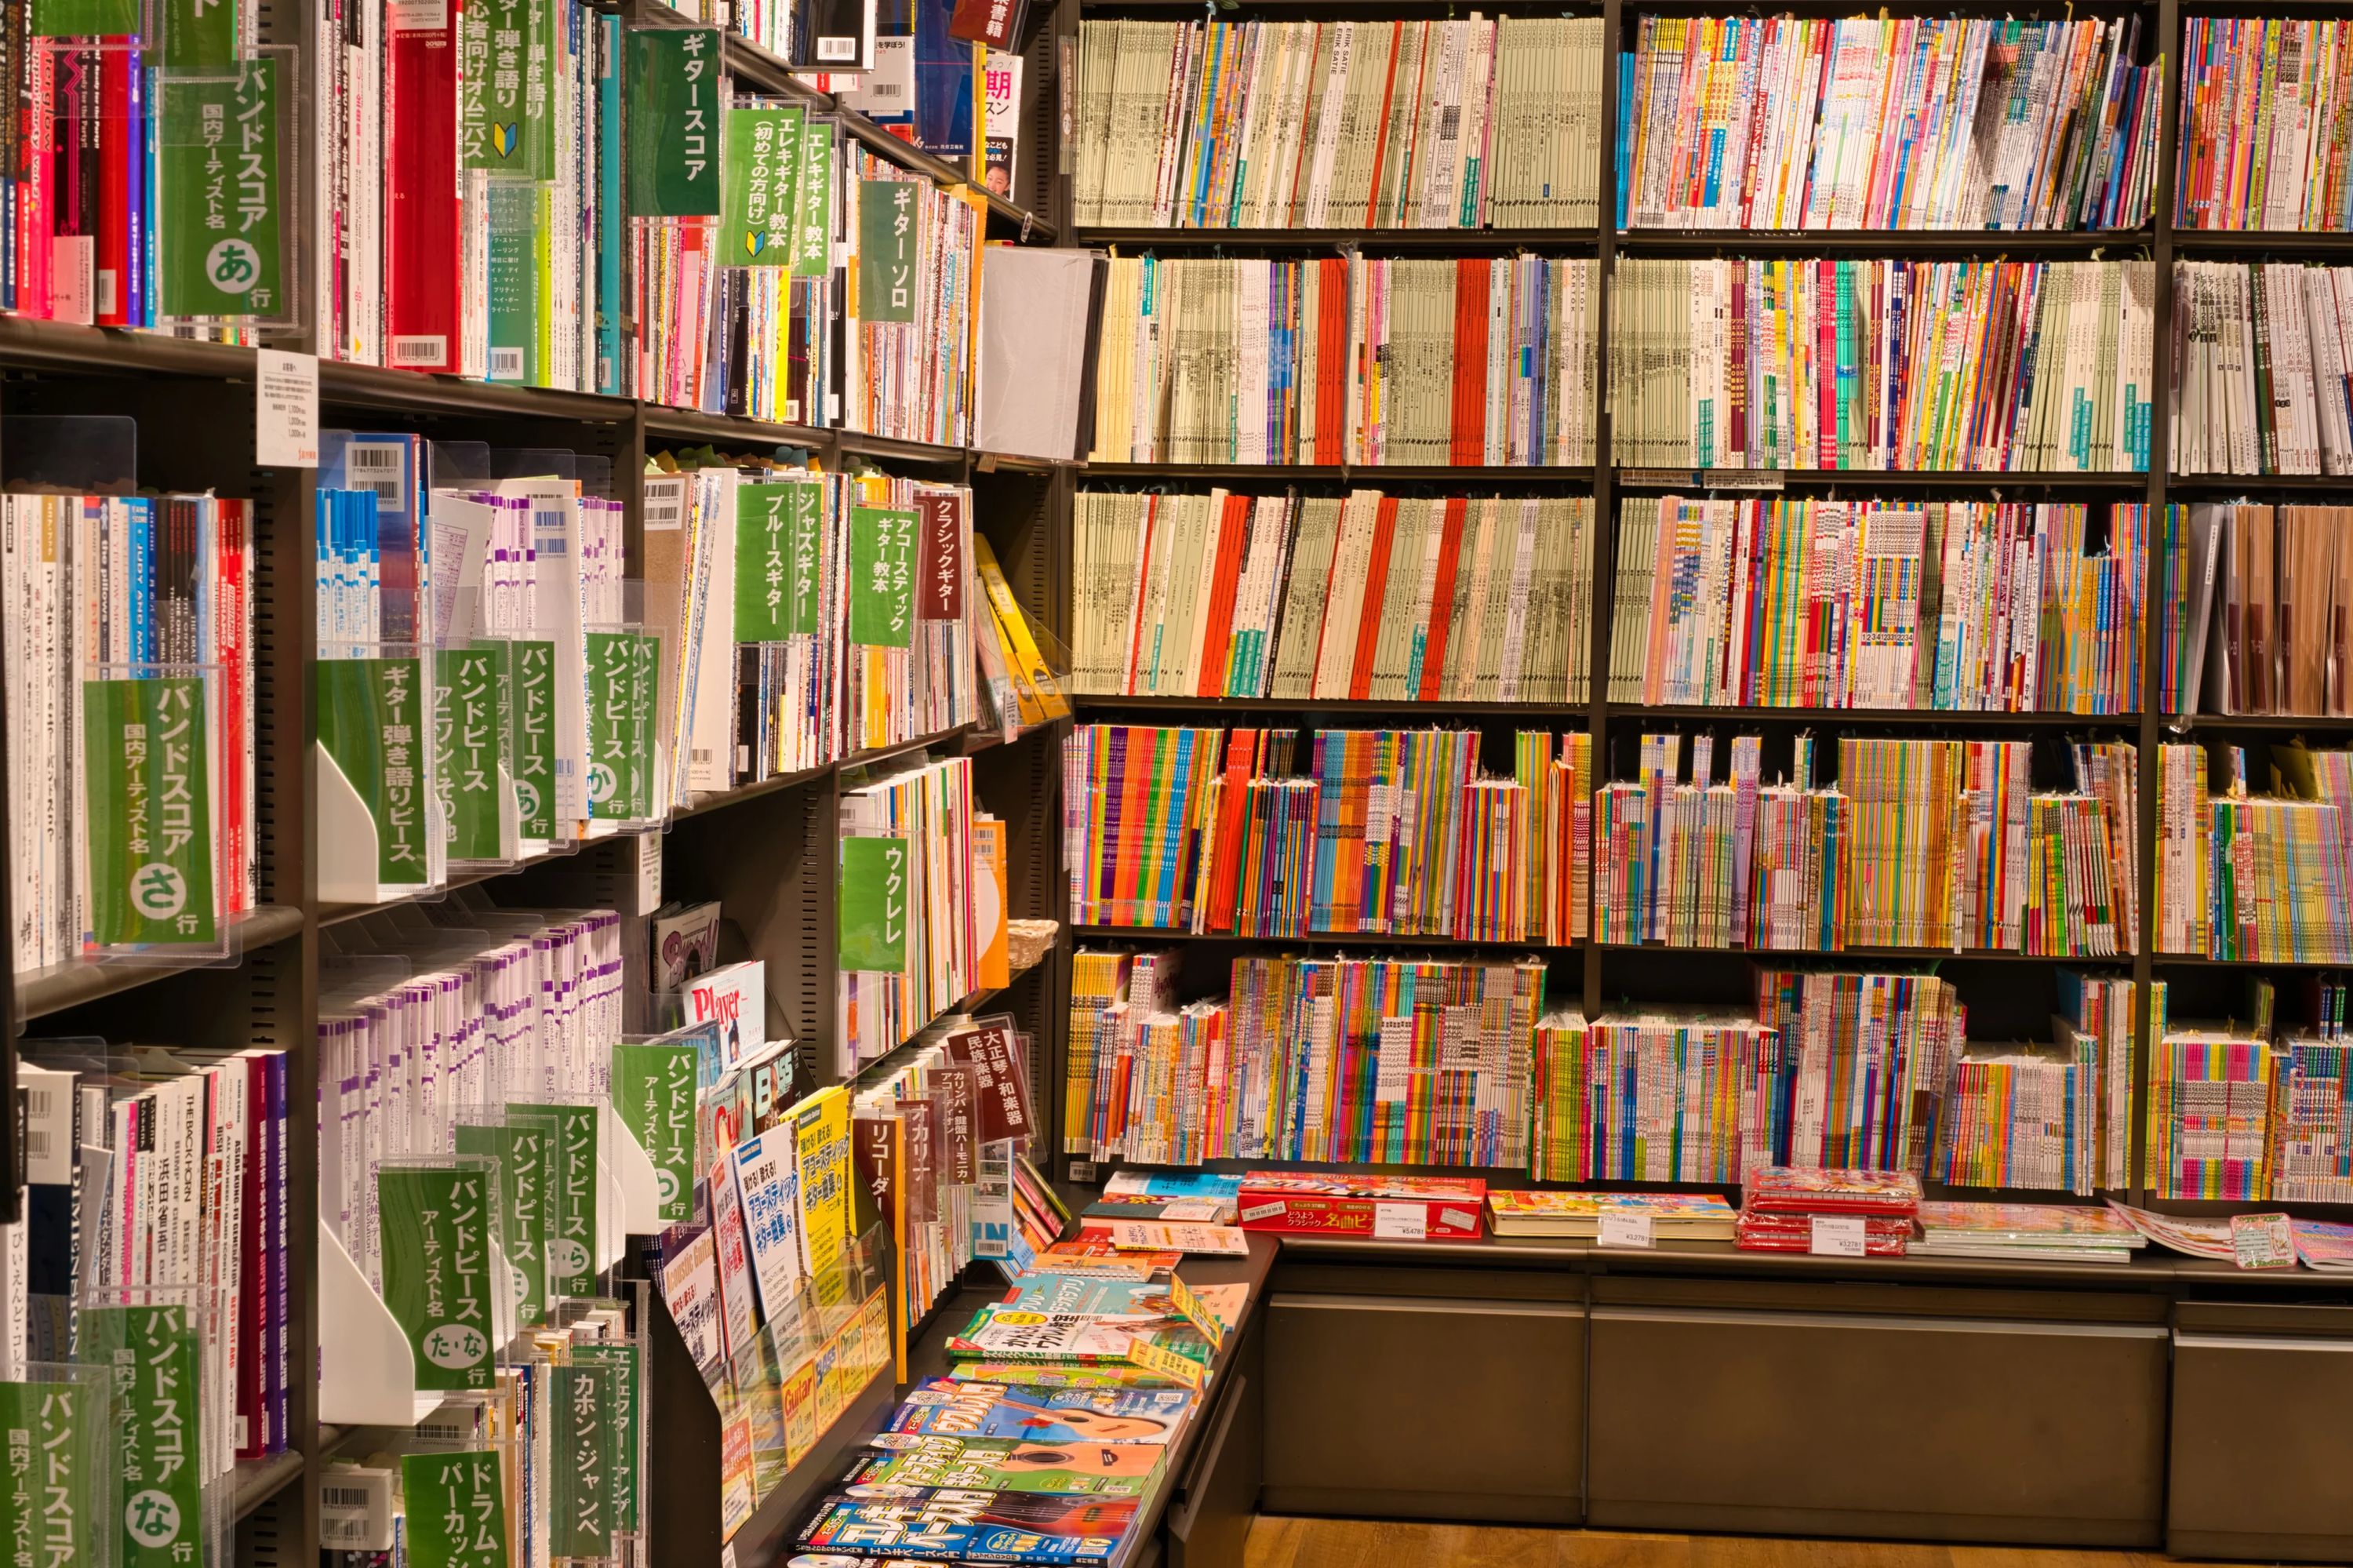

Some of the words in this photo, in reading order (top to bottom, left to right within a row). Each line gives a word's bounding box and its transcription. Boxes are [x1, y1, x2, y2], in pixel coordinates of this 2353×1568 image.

[1344, 27, 1352, 49] ERIK
[235, 67, 267, 232] バンドスコア
[682, 33, 706, 181] ギタースコア
[202, 104, 226, 229] 国内アーティスト名
[768, 118, 795, 248] エレキギター教本
[804, 133, 825, 260] エレキギター教本
[215, 244, 253, 283] あ
[891, 187, 913, 308] ギターソロ
[250, 288, 271, 307] 行
[136, 543, 144, 584] JUDY
[766, 495, 784, 624] ブルースギター
[798, 492, 816, 617] ジャズギター
[872, 518, 894, 592] ギター教本
[890, 518, 913, 632] アコースティック
[936, 500, 955, 612] クラシックギター
[460, 657, 489, 792] バンドピース
[522, 648, 547, 776] バンドピース
[602, 640, 628, 759] バンドピース
[124, 724, 149, 853] 国内アーティスト名
[157, 686, 193, 857] バンドスコア
[382, 666, 416, 863] ギター弾き語りピース
[609, 800, 624, 813] 行
[532, 820, 548, 834] 行
[140, 868, 178, 908] さ
[176, 915, 198, 935] 行
[886, 847, 903, 944] ウクレレ
[692, 985, 740, 1034] Player
[667, 1053, 692, 1165] バンドピース
[967, 1037, 995, 1089] 民族楽器
[984, 1031, 1023, 1126] 大正琴・和楽器
[565, 1115, 590, 1236] バンドピース
[802, 1132, 849, 1183] アコースティック
[871, 1124, 889, 1211] リコーダー
[912, 1104, 931, 1181] オカリナ
[512, 1135, 538, 1261] バンドピース
[671, 1202, 686, 1217] 行
[747, 1170, 798, 1225] アコースティック
[1287, 1210, 1315, 1220] どうよう
[1287, 1219, 1321, 1228] クラシック
[421, 1210, 445, 1318] アーティスト名
[449, 1179, 482, 1322] バンドピース
[572, 1279, 587, 1293] 行
[521, 1304, 536, 1319] 行
[114, 1349, 143, 1481] 国内アーティスト名
[145, 1308, 185, 1483] バンドスコア
[467, 1369, 486, 1384] 行
[9, 1429, 33, 1568] 国内アーティスト名
[40, 1392, 75, 1568] バンドスコア
[573, 1373, 600, 1536] カホン・ジャンベ
[882, 1435, 965, 1486] アコースティック
[935, 1448, 1011, 1488] ギター入門
[134, 1497, 172, 1536] な
[172, 1542, 193, 1563] 行
[836, 1504, 918, 1546] エレキ
[870, 1547, 961, 1559] エレキベース入門
